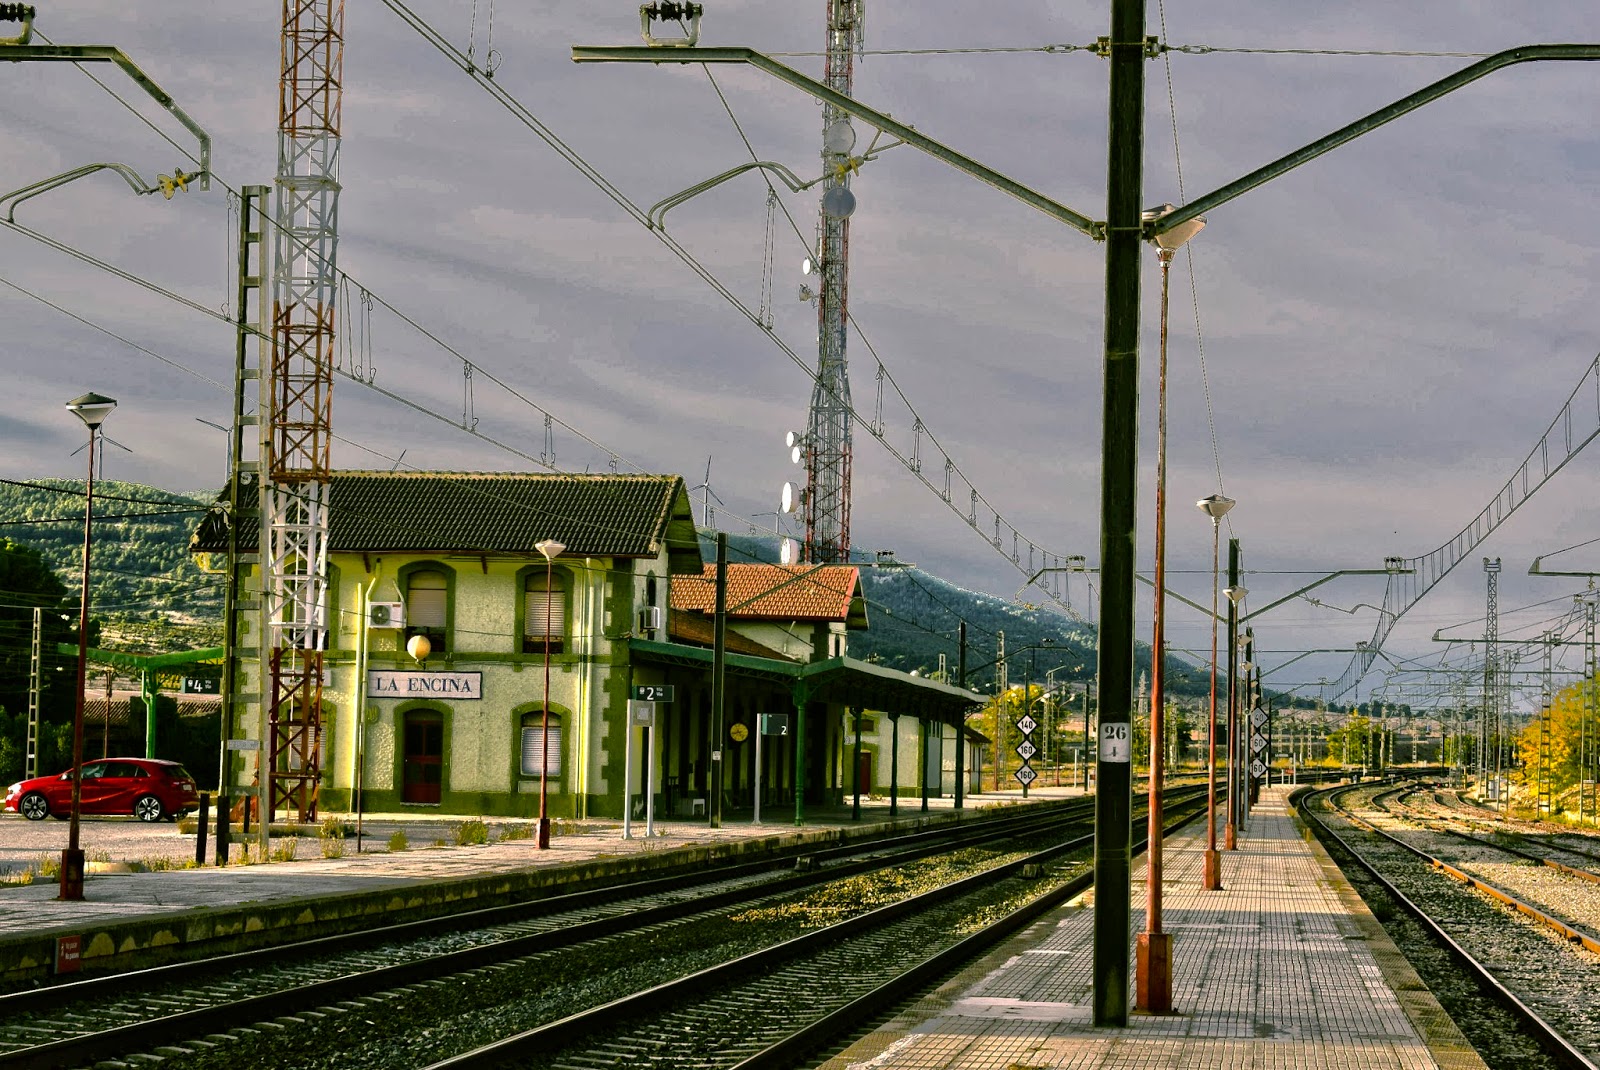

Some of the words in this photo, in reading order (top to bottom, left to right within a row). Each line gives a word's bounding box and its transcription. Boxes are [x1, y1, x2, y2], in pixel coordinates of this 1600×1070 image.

[193, 679, 203, 693] 4
[376, 677, 400, 692] LA
[407, 677, 472, 693] ENCINA
[646, 687, 655, 701] 2
[781, 725, 787, 735] 2
[1020, 720, 1034, 730] 140
[1104, 725, 1127, 740] 26
[1020, 745, 1033, 755] 160
[1019, 770, 1032, 780] 160
